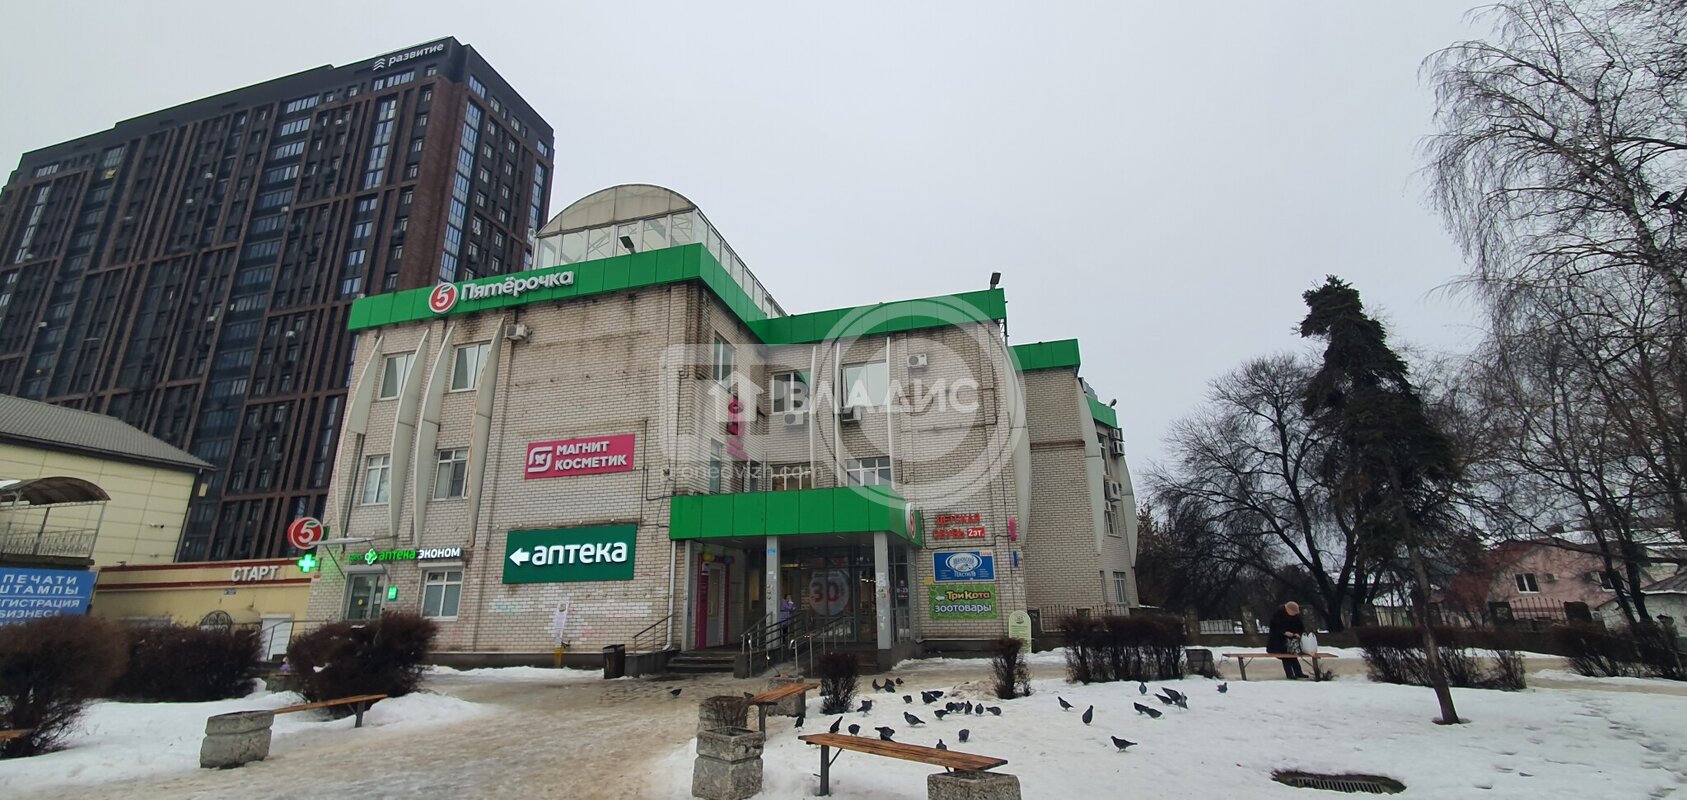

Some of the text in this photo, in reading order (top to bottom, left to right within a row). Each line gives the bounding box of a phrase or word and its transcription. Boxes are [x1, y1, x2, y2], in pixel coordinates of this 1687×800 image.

[388, 43, 444, 67] развитие
[435, 271, 575, 307] 5 Пятёрочка
[556, 441, 610, 456] МАГНИТ
[554, 454, 627, 471] КОСМЕТИК
[380, 549, 417, 560] аптека
[531, 541, 628, 566] аптека
[3, 574, 77, 585] ПЕЧАТИ
[231, 565, 279, 582] СТАРТ
[935, 604, 992, 614] зоотовары
